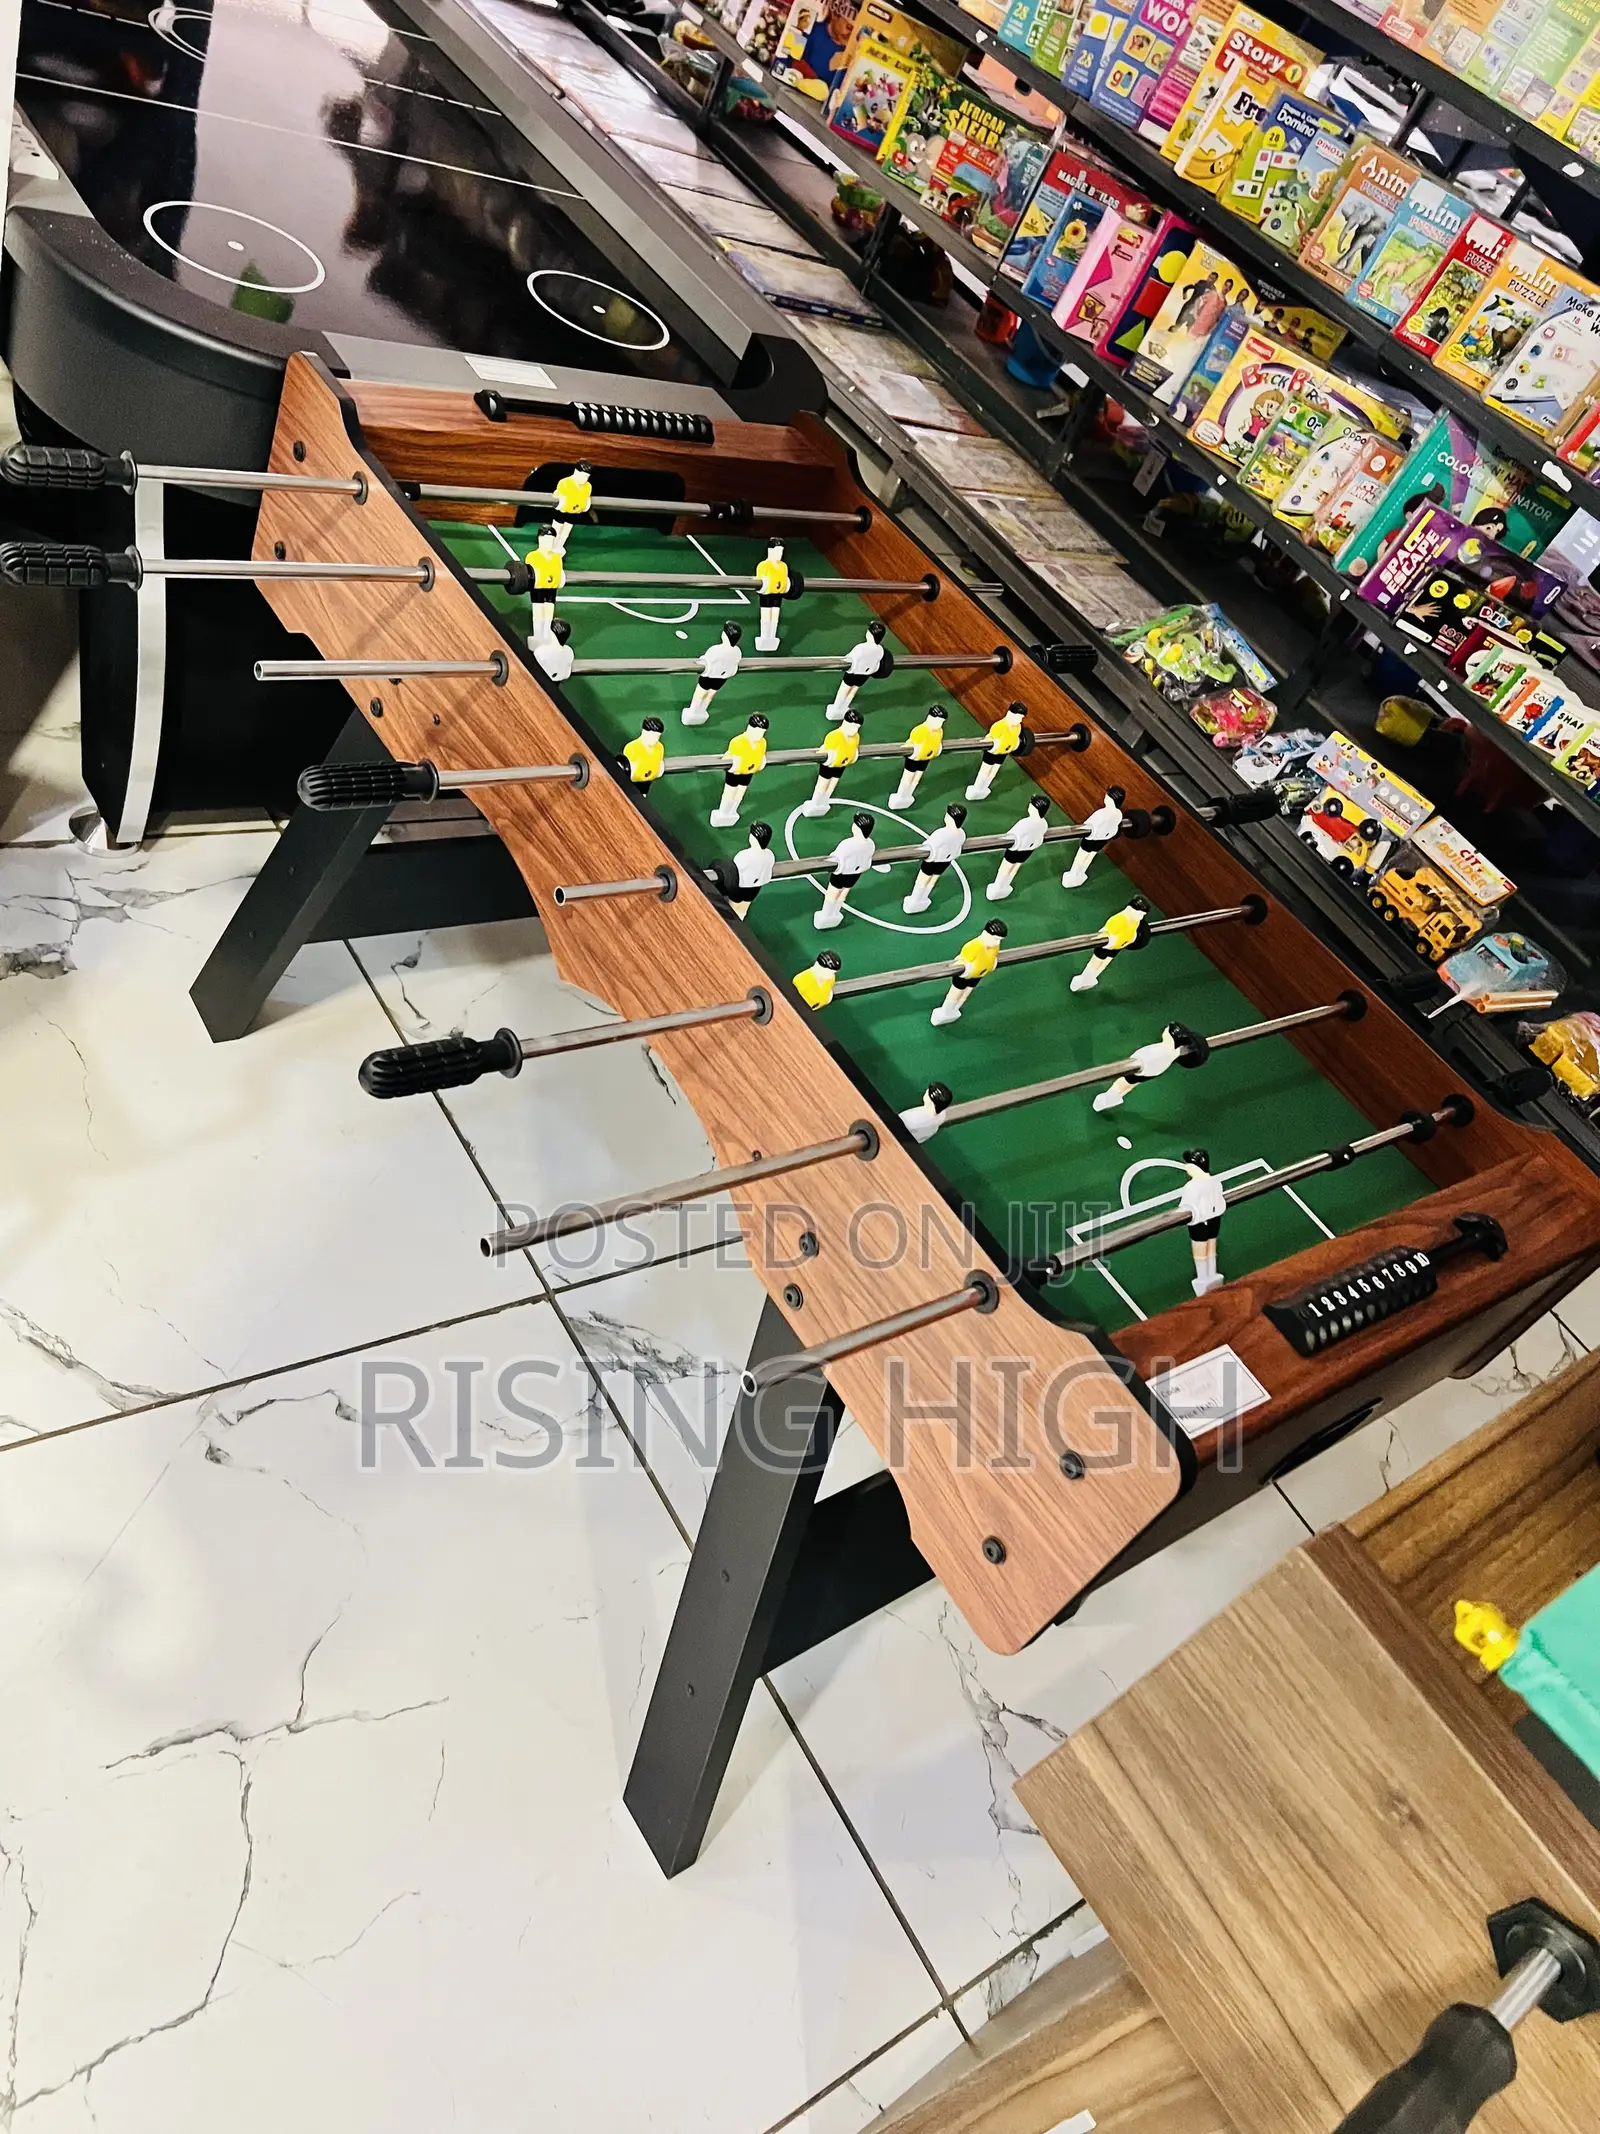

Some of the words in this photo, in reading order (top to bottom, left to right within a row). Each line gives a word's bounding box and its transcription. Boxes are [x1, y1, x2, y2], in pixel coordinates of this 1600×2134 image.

[1230, 30, 1285, 74] Story
[946, 108, 1003, 151] SAFAR
[959, 99, 1006, 135] AFRICAN
[1277, 109, 1316, 137] Domino
[1565, 296, 1594, 318] Make
[1386, 529, 1440, 596] ESCAPE
[1460, 849, 1485, 873] CIT
[1308, 1302, 1323, 1317] 1
[1320, 1296, 1336, 1311] 2
[1333, 1290, 1348, 1305] 3
[1347, 1284, 1360, 1299] 4
[1356, 1278, 1371, 1293] 5
[1371, 1275, 1385, 1290] 6
[1381, 1268, 1395, 1282] 7
[1392, 1263, 1406, 1277] 8
[1404, 1260, 1418, 1274] 9
[1413, 1252, 1430, 1267] 10
